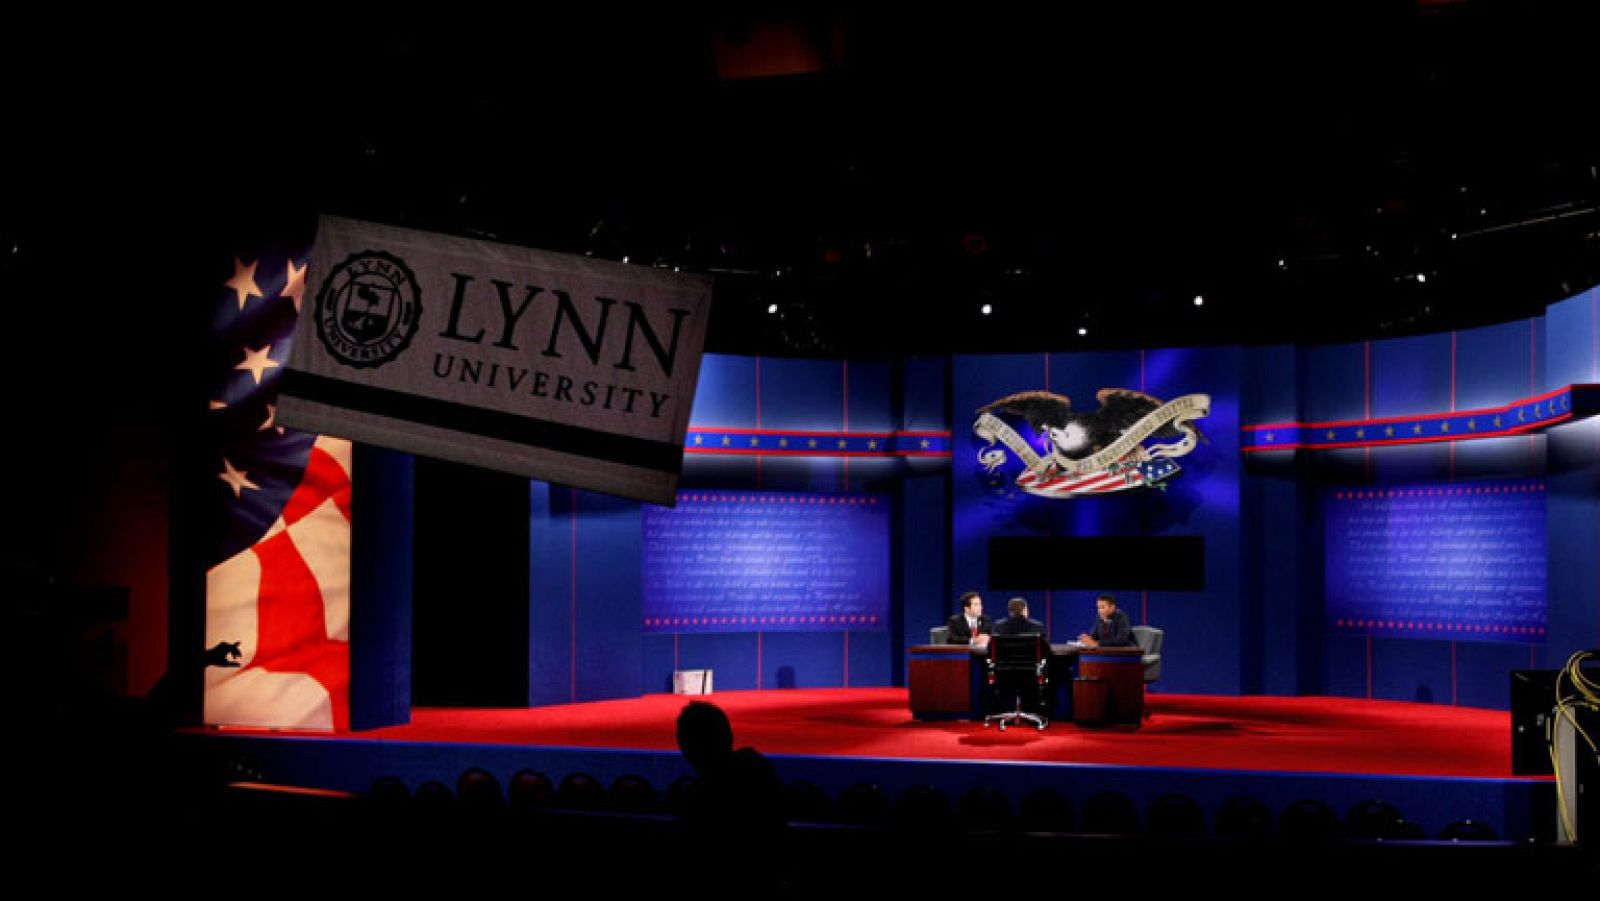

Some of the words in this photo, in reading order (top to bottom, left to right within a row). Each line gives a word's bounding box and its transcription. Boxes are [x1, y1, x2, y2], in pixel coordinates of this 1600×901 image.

[346, 259, 406, 285] LYNN
[324, 317, 405, 360] UNIVERSITY
[439, 273, 691, 379] LYNN
[434, 353, 670, 418] UNIVERSITY
